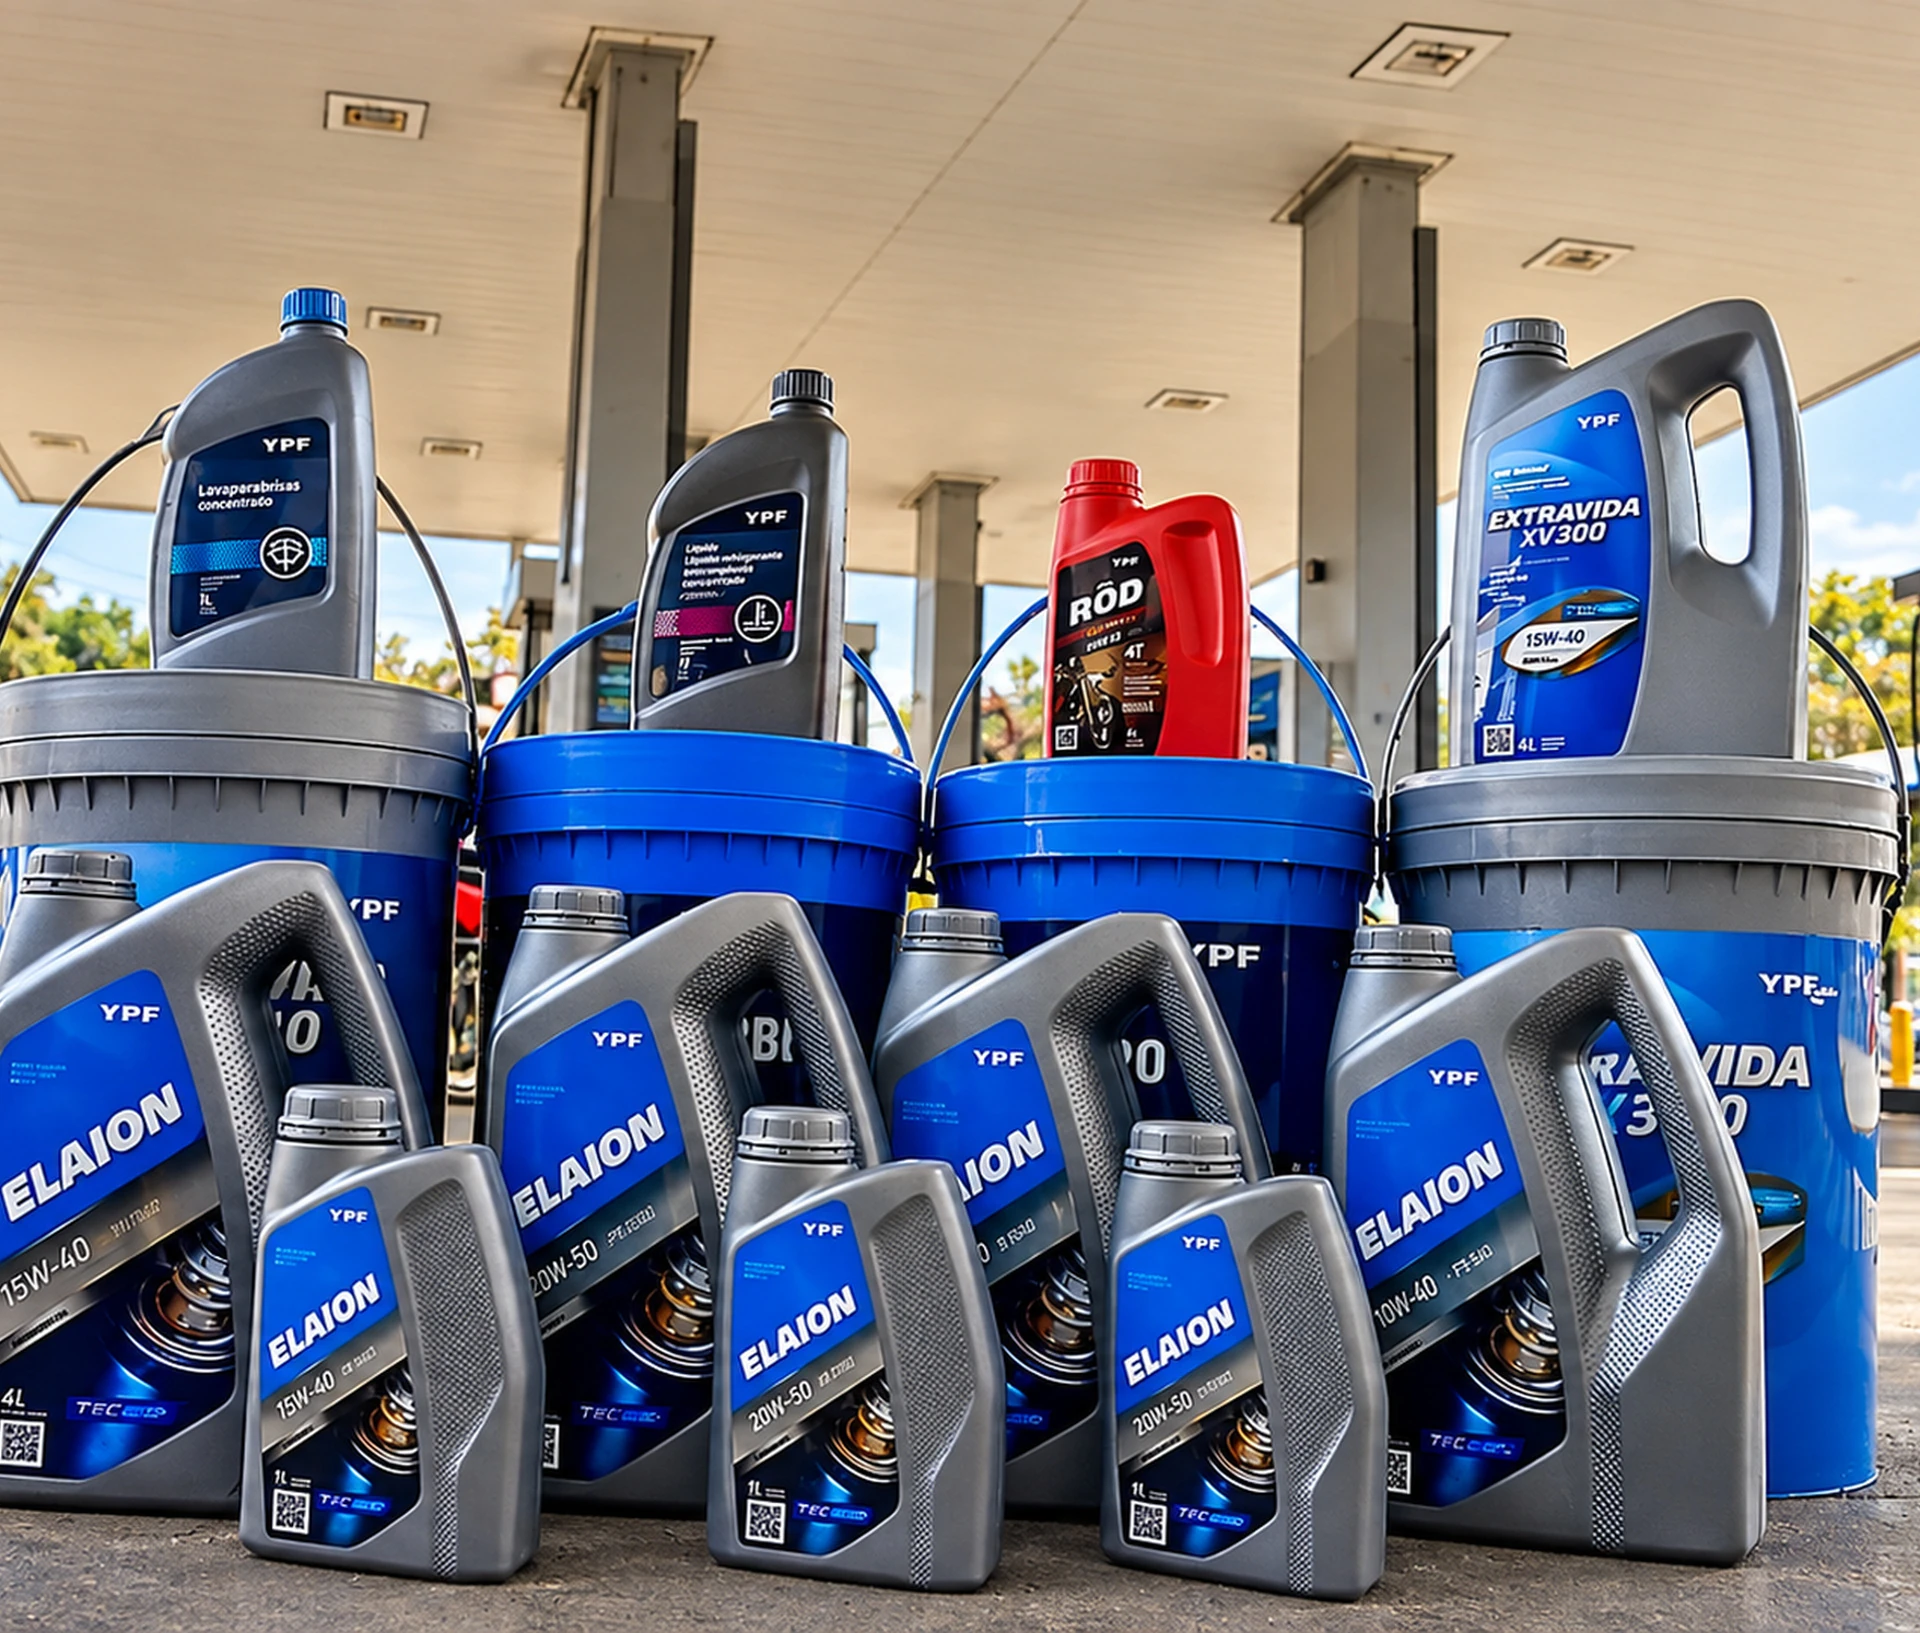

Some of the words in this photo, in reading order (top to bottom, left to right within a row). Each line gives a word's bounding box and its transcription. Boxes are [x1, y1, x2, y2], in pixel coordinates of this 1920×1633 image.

[1577, 413, 1621, 429] YPF
[263, 437, 311, 452] YPF
[198, 478, 301, 497] Lavaparabrisas
[745, 510, 787, 524] YPF
[1487, 497, 1640, 532] EXTRAVIDA
[1520, 522, 1607, 548] XV300
[1526, 629, 1585, 648] 15W-40
[1124, 642, 1145, 659] 4T
[1518, 737, 1537, 751] 4L
[1759, 973, 1819, 995] YPF
[100, 1004, 160, 1023] YPF
[592, 1031, 643, 1048] YPF
[973, 1050, 1024, 1067] YPF
[1429, 1069, 1479, 1086] YPF
[1, 1082, 183, 1222] ELAION
[512, 1103, 665, 1229] ELAION
[1355, 1141, 1503, 1261] ELAION
[330, 1208, 368, 1223] YPF
[803, 1222, 844, 1237] YPF
[1182, 1236, 1220, 1251] YPF
[1, 1236, 91, 1307] 15W-40
[1374, 1275, 1438, 1328] 10W-40
[268, 1273, 380, 1369] ELAION
[739, 1285, 856, 1380] ELAION
[1123, 1298, 1235, 1387] ELAION
[1, 1388, 25, 1408] 4L
[276, 1370, 335, 1419] 15W-40
[76, 1401, 122, 1417] TEC
[580, 1405, 622, 1421] TEC
[748, 1380, 812, 1433] 20W-50
[1132, 1390, 1193, 1436] 20W-50
[274, 1469, 287, 1484] 1L
[748, 1480, 762, 1496] 1L
[1131, 1482, 1146, 1499] 1L
[798, 1503, 830, 1518] TEC
